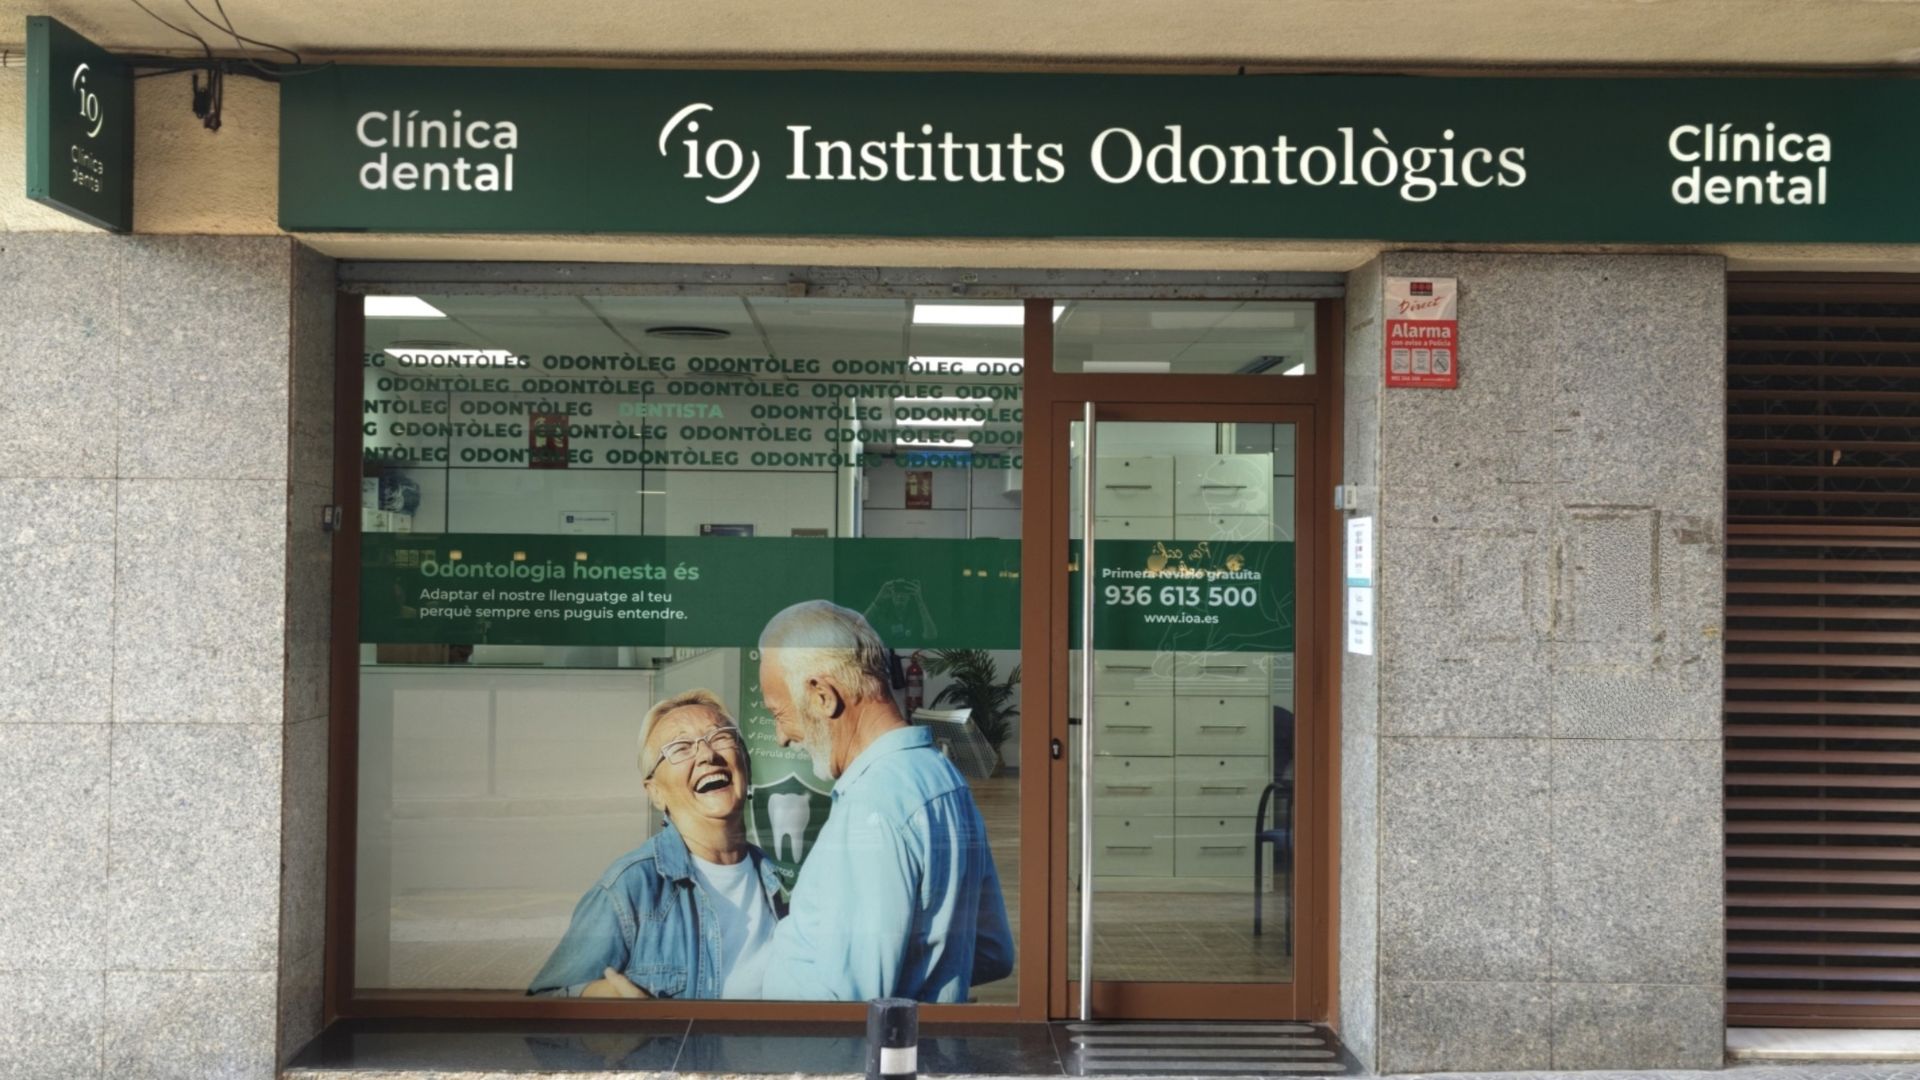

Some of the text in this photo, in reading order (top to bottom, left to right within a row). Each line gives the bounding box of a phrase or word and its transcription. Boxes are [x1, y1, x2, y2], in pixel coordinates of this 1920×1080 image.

[356, 109, 518, 149] Clínica
[1668, 122, 1831, 162] Clínica
[359, 152, 513, 191] dental
[786, 123, 1527, 202] Instituts Odontològics
[1671, 166, 1827, 205] dental
[1391, 322, 1451, 338] Alarma
[398, 350, 531, 369] ODONTÒLEG
[542, 352, 676, 371] ODONTÒLEG
[687, 353, 820, 373] ODONTÒLEG
[832, 356, 963, 376] ODONTÒLEG
[377, 374, 510, 392] ODONTÒLEG
[521, 376, 655, 395] ODONTÒLEG
[667, 377, 800, 397] ODONTÒLEG
[955, 386, 1023, 400] ODON
[460, 397, 593, 416] ODONTÒLEG
[618, 402, 725, 419] DENTISTA
[751, 402, 883, 420] ODONTÒLEG
[390, 419, 522, 438] ODONTÒLEG
[679, 422, 812, 441] ODONTÒLEG
[824, 426, 956, 443] ODONTÒLEG
[460, 446, 594, 464] ODONTEG
[606, 446, 739, 466] ODONTÒLEG
[420, 560, 700, 583] Odontologia honesta és
[1102, 567, 1155, 579] Primera
[420, 588, 672, 605] Adaptar el nostre llenguatge al teu
[1105, 585, 1257, 607] 936 613 500
[420, 605, 688, 621] perquè sempre ens puguis entendre.
[1143, 612, 1220, 624] www.ioa.es
